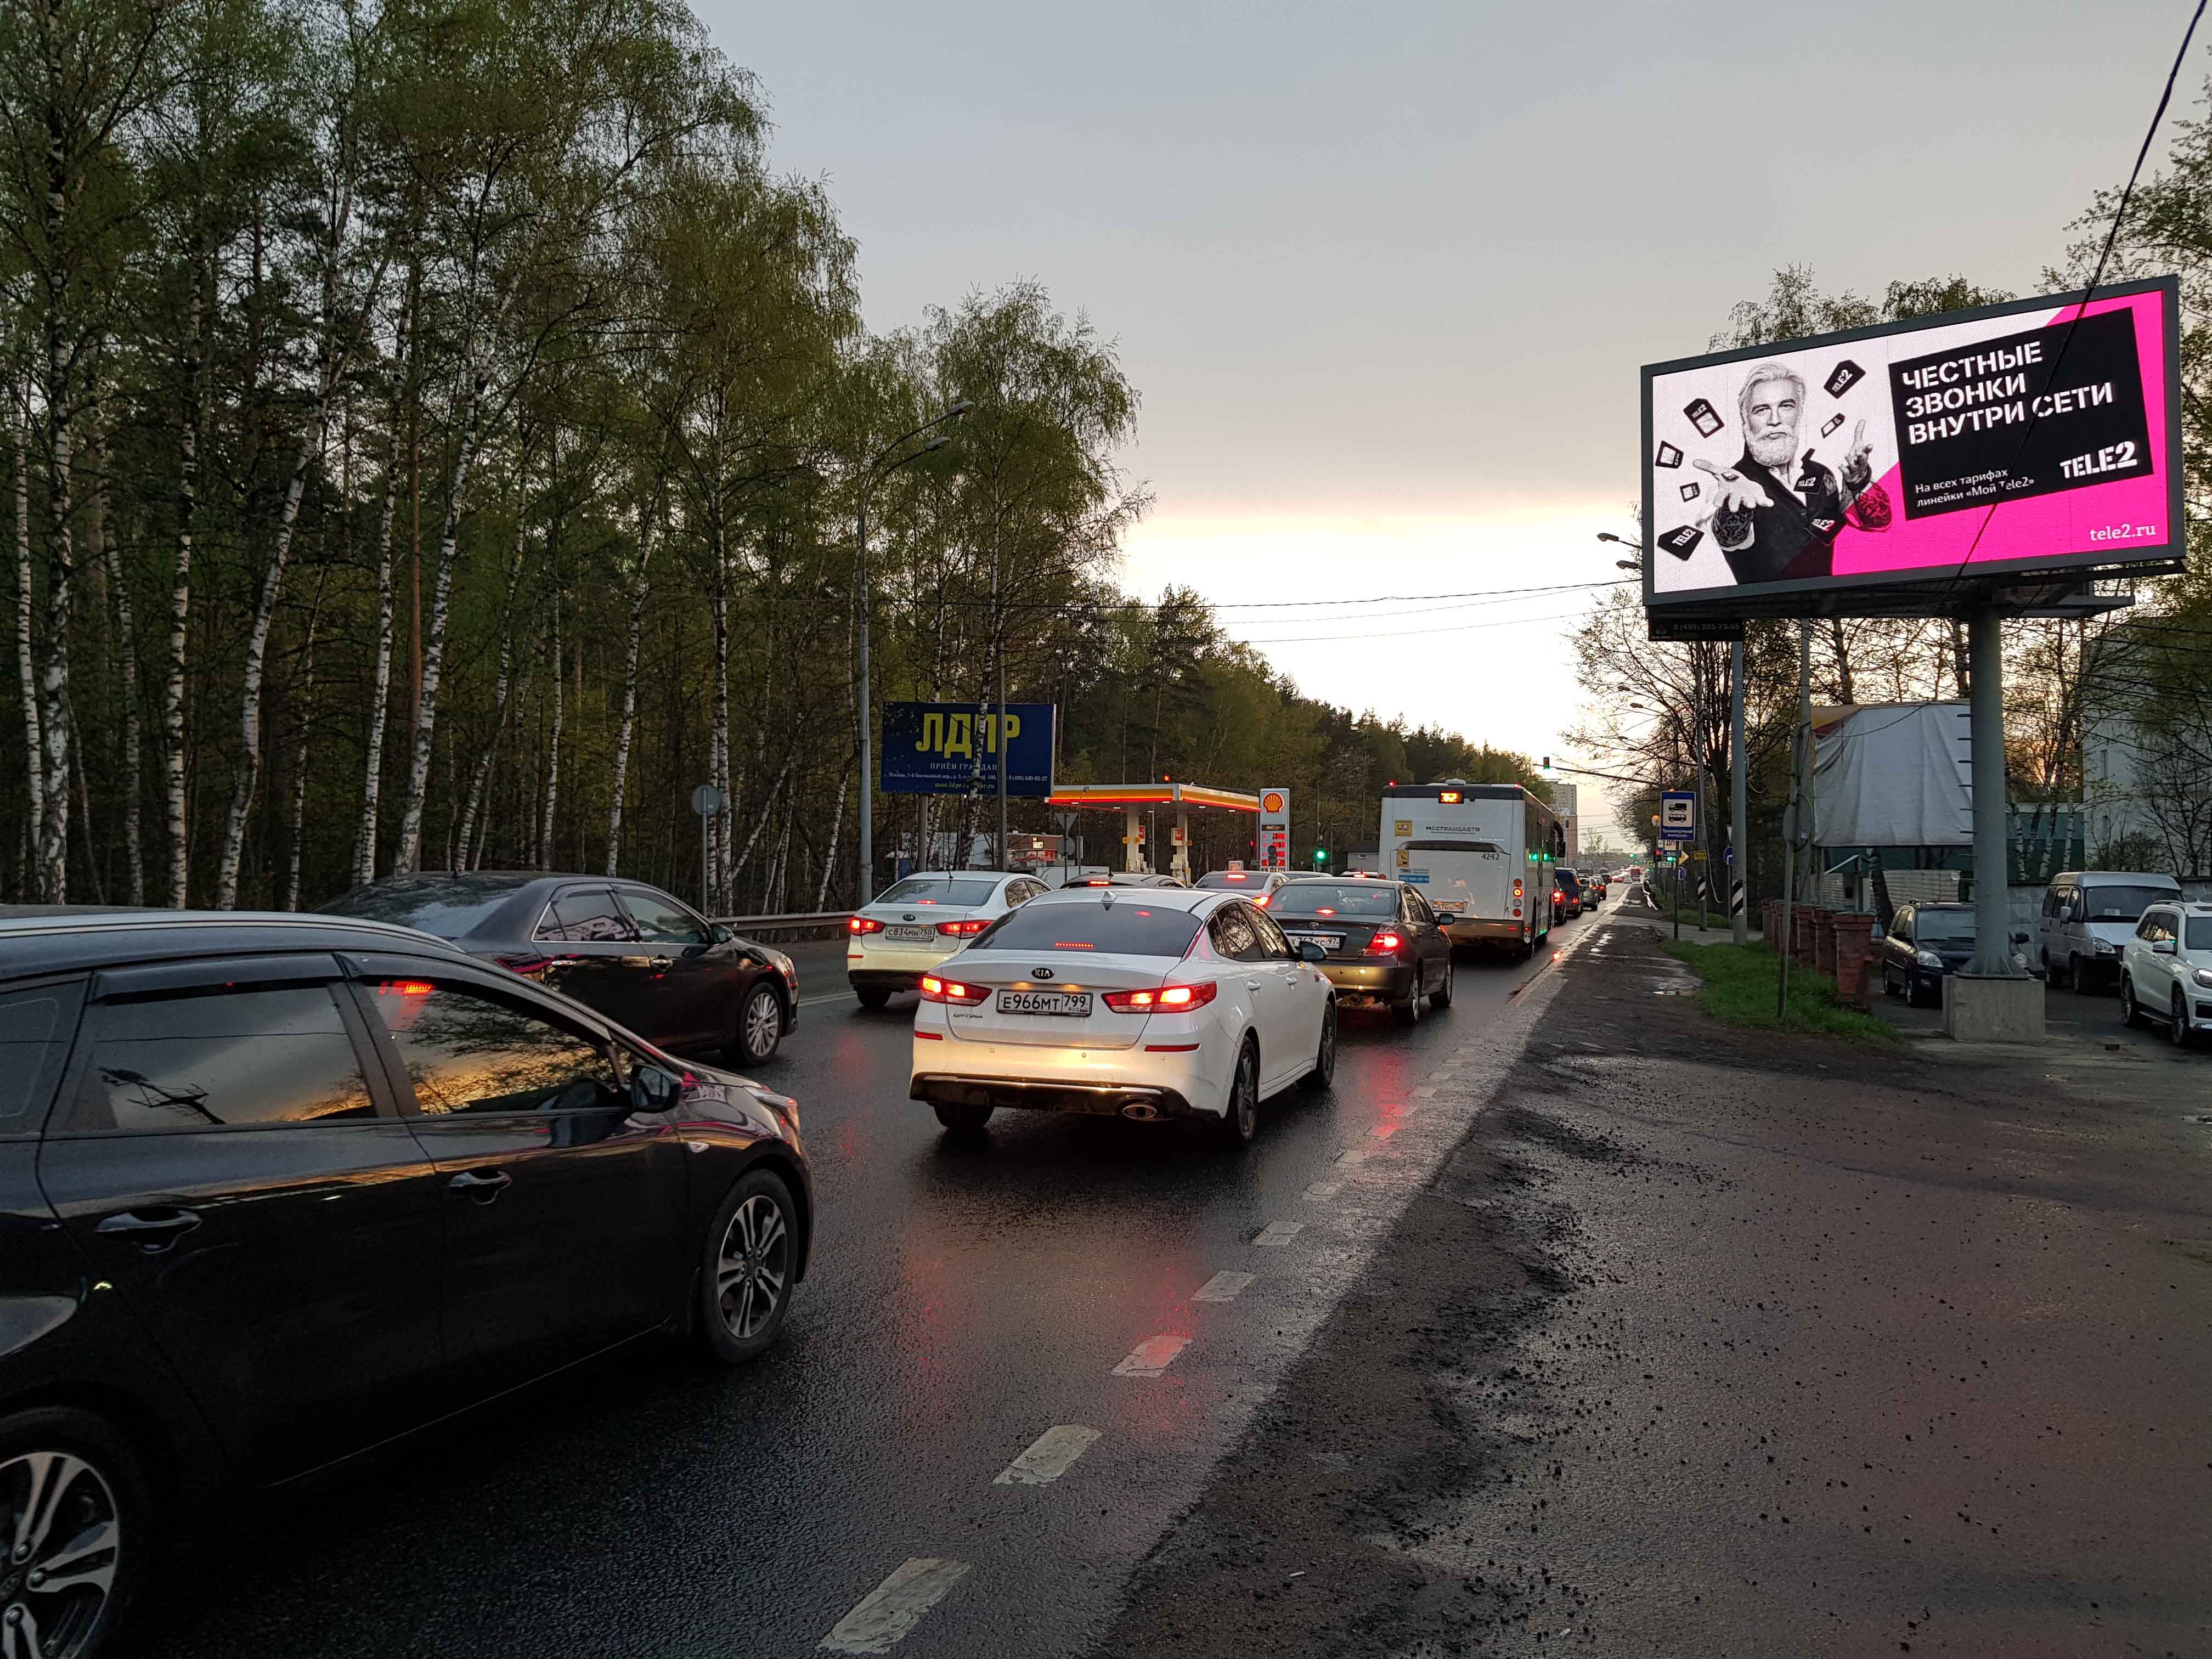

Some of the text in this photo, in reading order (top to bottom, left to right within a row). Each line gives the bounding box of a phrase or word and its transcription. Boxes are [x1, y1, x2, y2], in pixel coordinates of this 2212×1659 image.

[1903, 341, 2042, 390] ЧЕСТНЫЕ
[1832, 369, 1853, 393] TELE2
[1905, 373, 2027, 417] ЗВОНКИ
[1909, 382, 2113, 444] ВНУТРИ СЕТИ
[2059, 441, 2138, 478] TELE2
[1915, 469, 2008, 494] На всех тарифах
[1917, 490, 1963, 507] линейки
[1966, 483, 1996, 498] «Мой
[1672, 528, 1696, 546] TELE2
[2090, 523, 2157, 541] tele2.ru
[915, 713, 1020, 759] ЛДПР
[930, 761, 997, 771] ПРИЁМ ГРАДАН
[888, 928, 918, 936] С834МН
[1035, 969, 1051, 977] KIA
[1003, 994, 1086, 1011] Е966МТ 799
